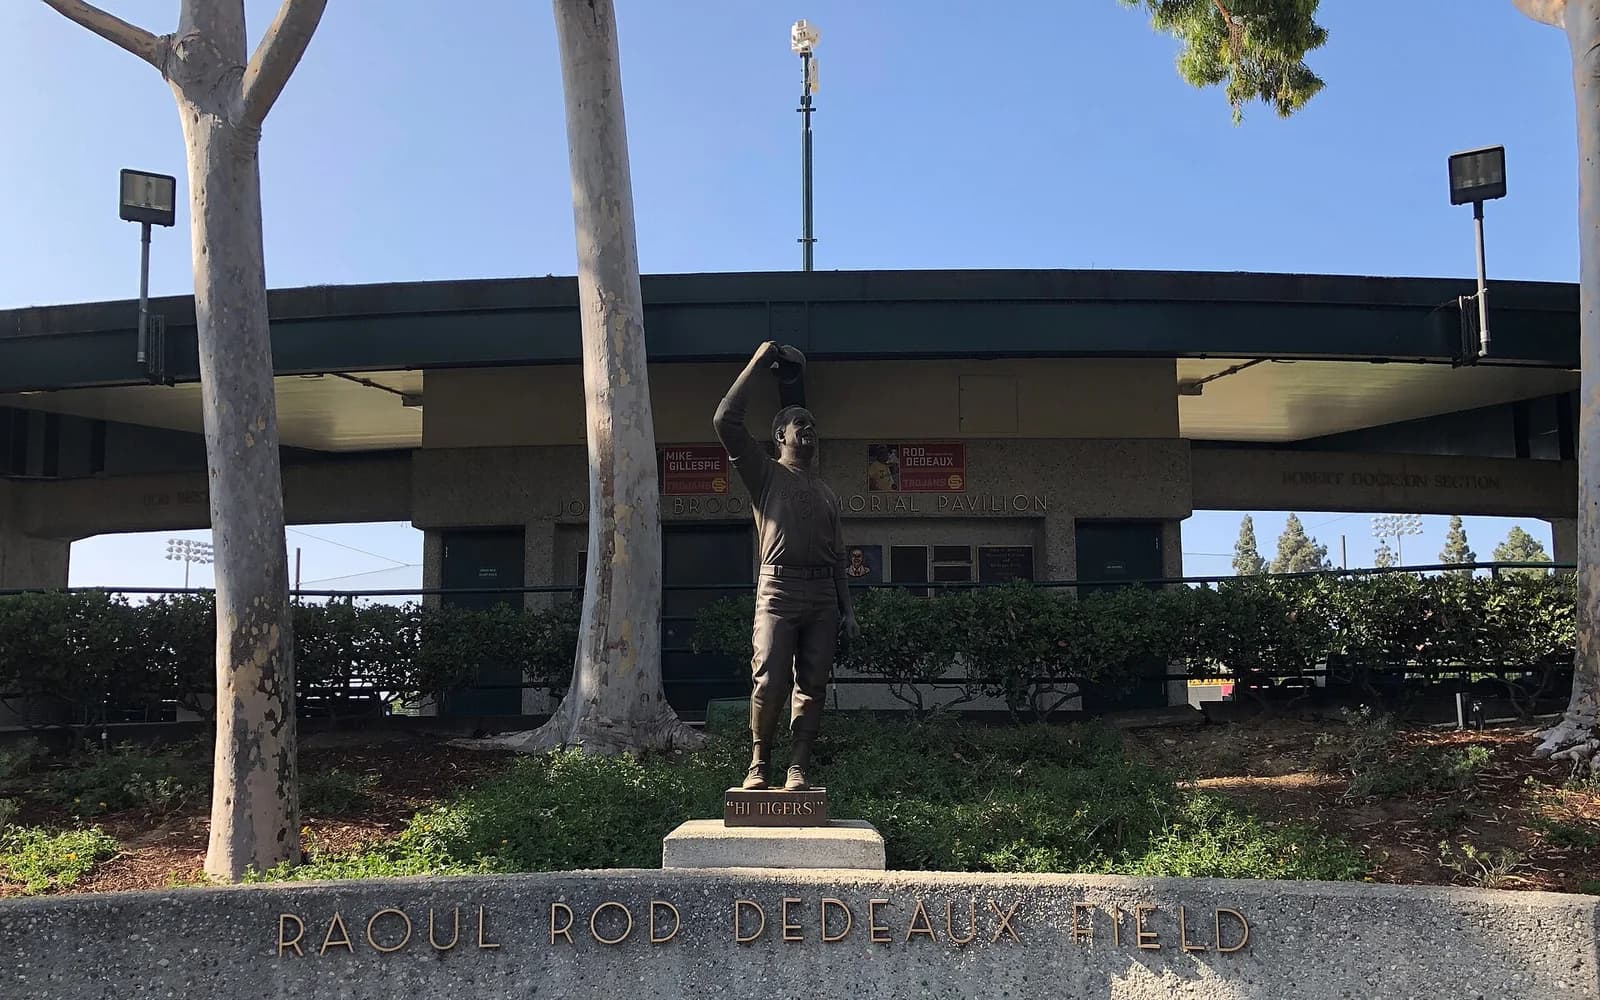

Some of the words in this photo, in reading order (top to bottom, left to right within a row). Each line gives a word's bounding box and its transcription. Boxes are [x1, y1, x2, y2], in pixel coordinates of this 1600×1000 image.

[666, 451, 692, 461] MIKE
[902, 447, 925, 457] ROD
[669, 460, 721, 471] GILLESPIE
[906, 457, 953, 466] DEDEAUX
[1434, 474, 1501, 489] SECTION
[674, 497, 752, 514] BROO
[938, 494, 1048, 512] PAVILION
[278, 905, 500, 957] RAOUL
[550, 900, 681, 945] ROD
[734, 898, 1021, 945] DEDEAUX
[1073, 900, 1250, 952] FIELD
